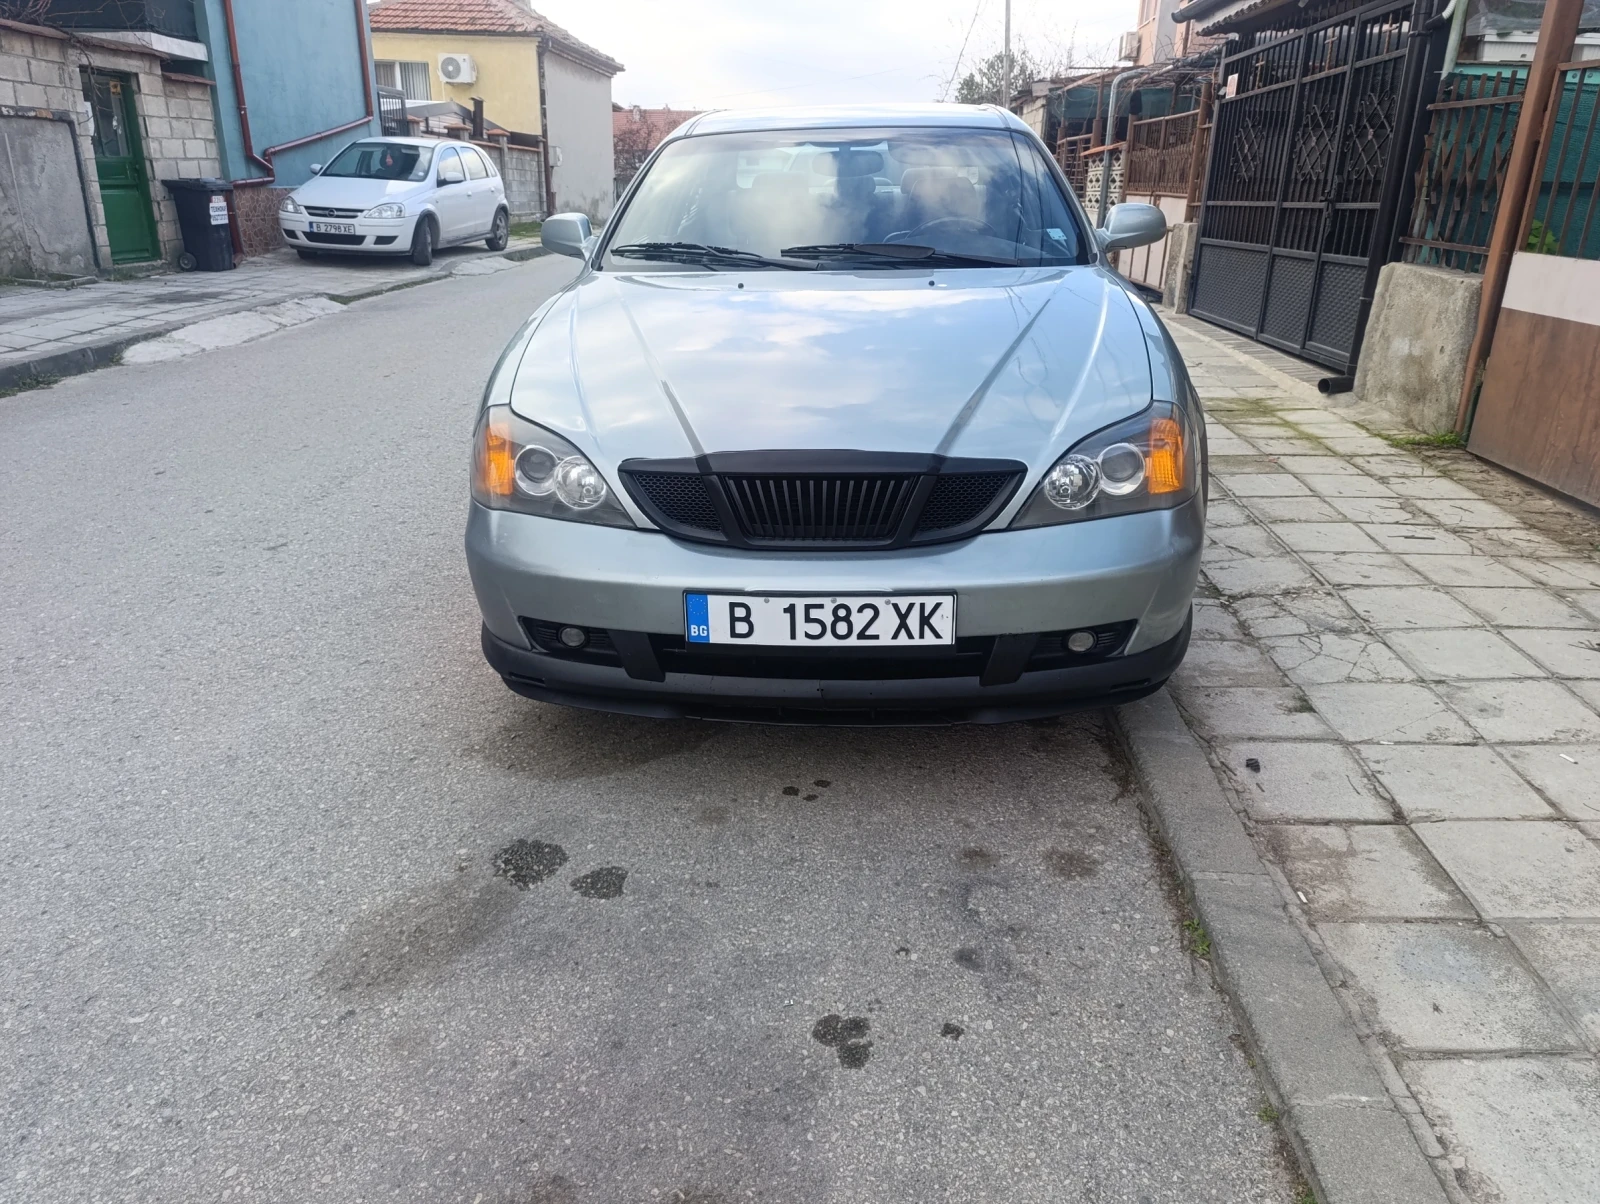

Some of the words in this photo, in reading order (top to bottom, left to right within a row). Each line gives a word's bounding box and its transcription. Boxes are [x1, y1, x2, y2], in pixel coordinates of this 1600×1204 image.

[316, 223, 322, 232] B
[343, 225, 353, 234] XE
[728, 601, 755, 639] B
[783, 602, 880, 641] 1582
[890, 601, 944, 640] XK
[690, 624, 708, 637] BG
